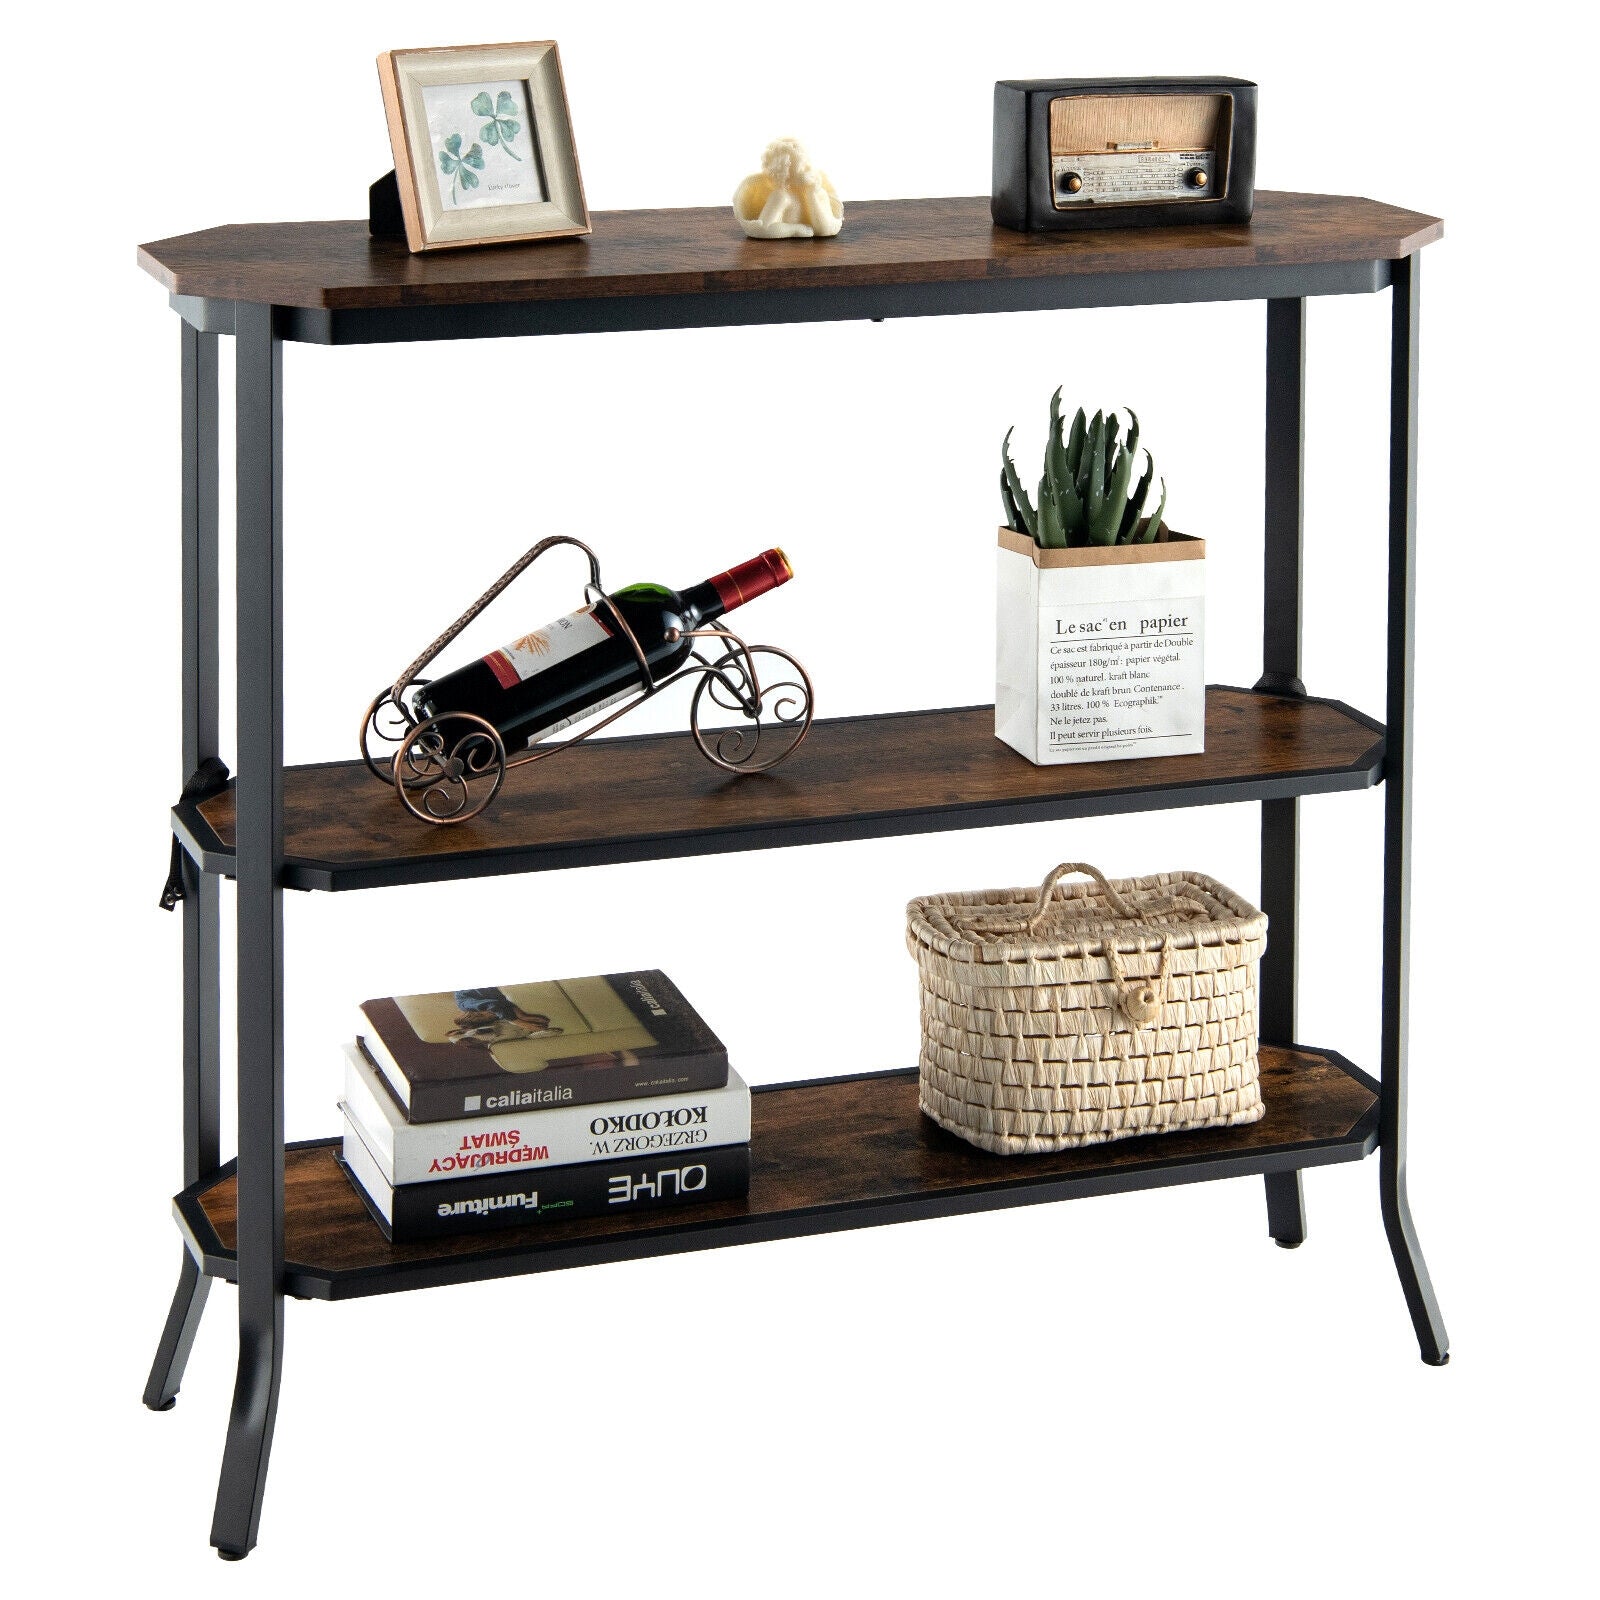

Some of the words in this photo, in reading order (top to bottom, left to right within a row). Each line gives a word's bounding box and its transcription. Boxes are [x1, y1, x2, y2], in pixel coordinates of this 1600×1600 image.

[1056, 619, 1076, 634] Le
[1109, 619, 1127, 631] en
[1140, 614, 1188, 634] papier
[1050, 646, 1061, 654] Ce
[1089, 643, 1122, 654] fabriqué
[1130, 641, 1153, 652] partir
[1153, 639, 1163, 648] de
[1164, 637, 1194, 648] Double
[1050, 660, 1086, 671] épaisseur
[1125, 655, 1150, 666] papier
[1152, 652, 1181, 664] végétal.
[1050, 675, 1064, 684] 100
[1076, 673, 1107, 683] naturel.
[1109, 671, 1127, 681] kraft
[1129, 671, 1150, 680] blanc
[1080, 688, 1090, 698] de
[1092, 686, 1110, 697] kraft
[1112, 686, 1131, 695] brun
[1050, 703, 1060, 712] 33
[1062, 701, 1083, 711] litres.
[1086, 700, 1100, 709] 100
[1102, 700, 1109, 708] %
[1050, 717, 1063, 726] Ne
[1064, 716, 1071, 725] le
[1072, 716, 1091, 727] jetez
[1093, 716, 1108, 726] pas.
[1050, 731, 1056, 740] Il
[1058, 731, 1076, 741] peut
[1077, 730, 1100, 739] servir
[1101, 727, 1136, 740] plusieurs
[1137, 725, 1153, 734] fois.
[486, 1085, 573, 1109] caliaitalia
[590, 1106, 708, 1136] KOŁODKO
[459, 1130, 520, 1151] ŚWIAT
[590, 1140, 609, 1156] W.
[613, 1128, 708, 1153] GRZEGORZ
[428, 1145, 549, 1173] WĘDRUJĄCY
[608, 1165, 707, 1204] OUYE
[438, 1191, 538, 1217] Furniture
